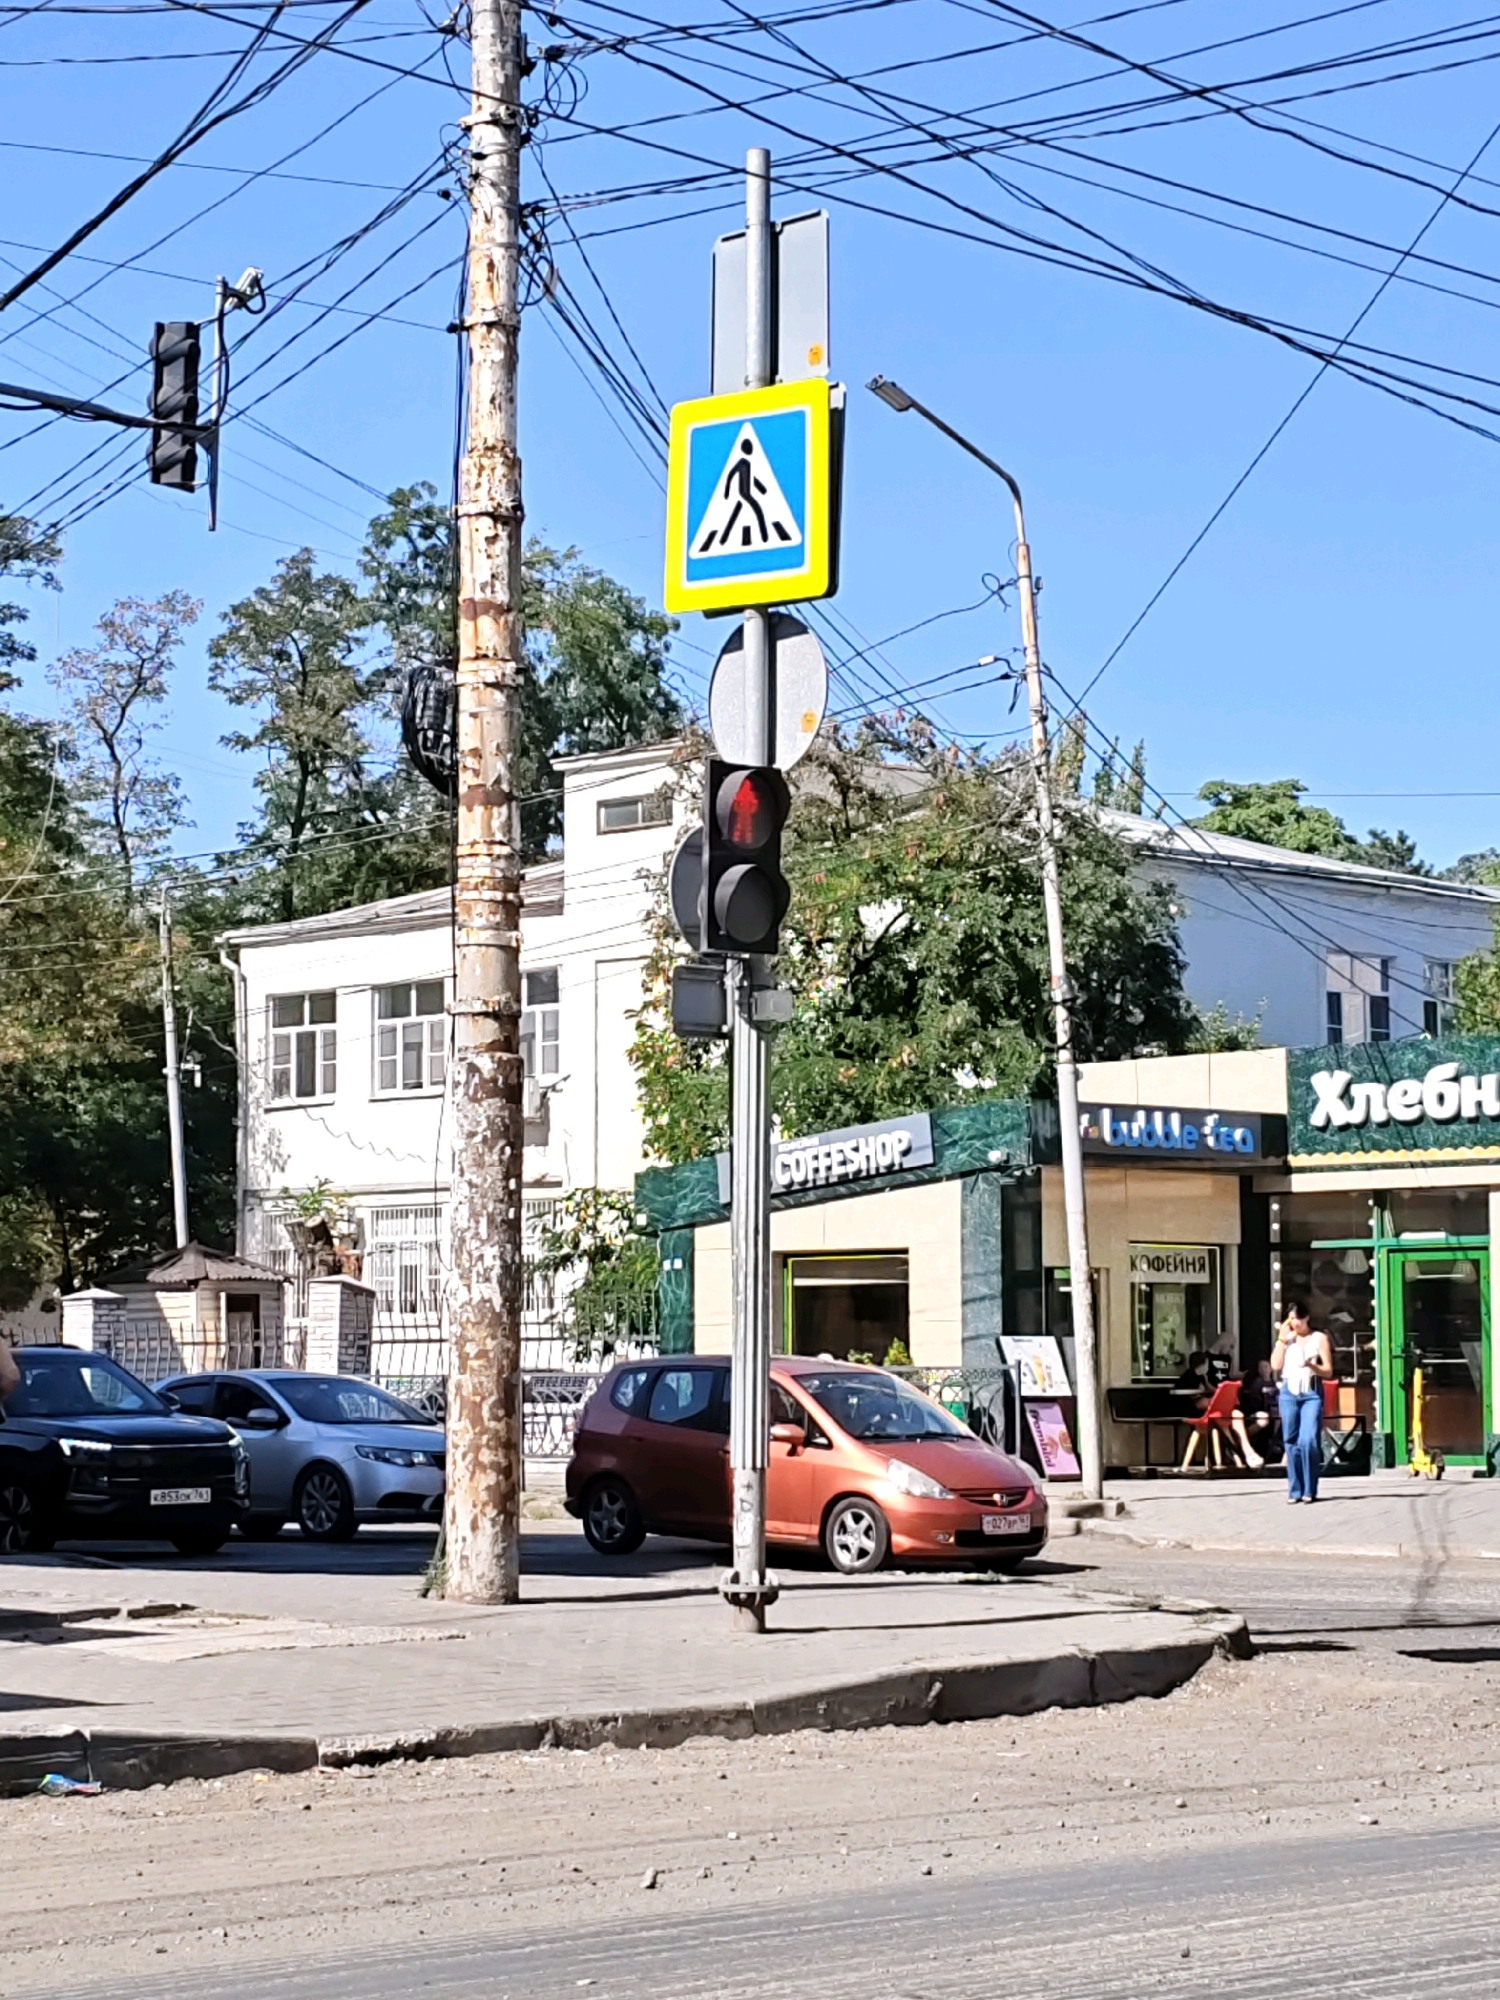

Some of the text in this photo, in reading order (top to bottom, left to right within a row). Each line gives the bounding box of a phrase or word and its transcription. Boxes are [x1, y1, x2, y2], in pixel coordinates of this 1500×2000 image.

[1310, 1062, 1500, 1127] Хлебн
[1100, 1108, 1254, 1153] bubble tea
[775, 1130, 911, 1186] COFFESHOP
[1129, 1252, 1206, 1274] КОФЕЙНЯ
